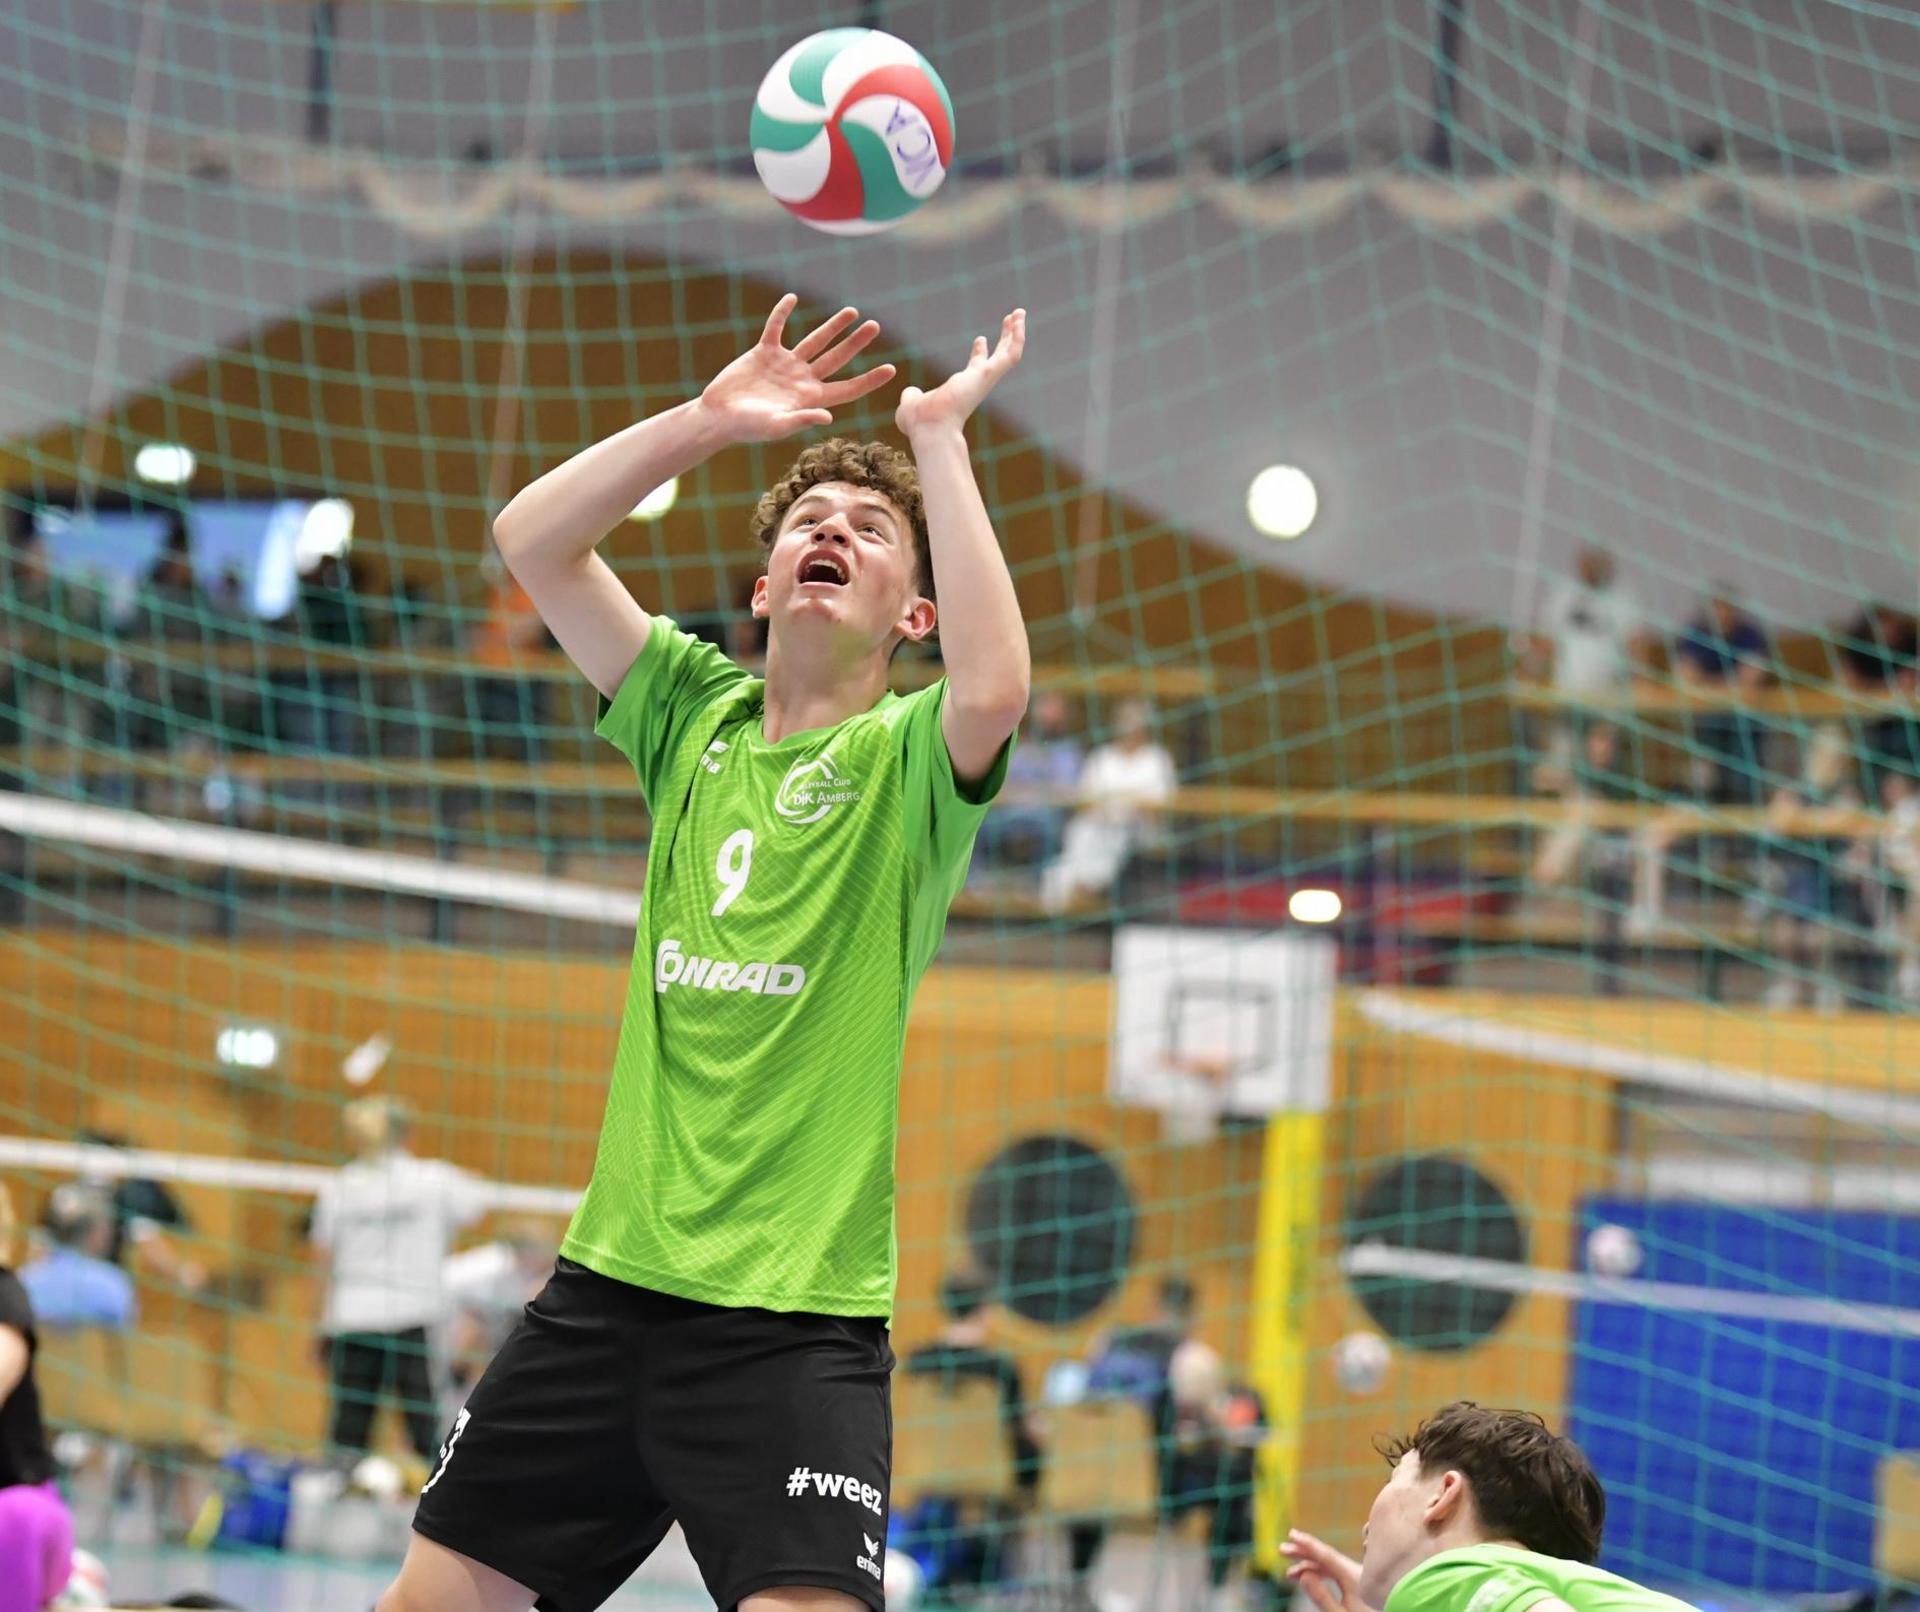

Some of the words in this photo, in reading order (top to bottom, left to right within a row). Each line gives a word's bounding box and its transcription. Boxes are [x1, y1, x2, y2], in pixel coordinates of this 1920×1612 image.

[711, 828, 754, 917] 9
[655, 939, 806, 996] CONRAD
[786, 1467, 882, 1516] #weez
[856, 1555, 881, 1580] erima
